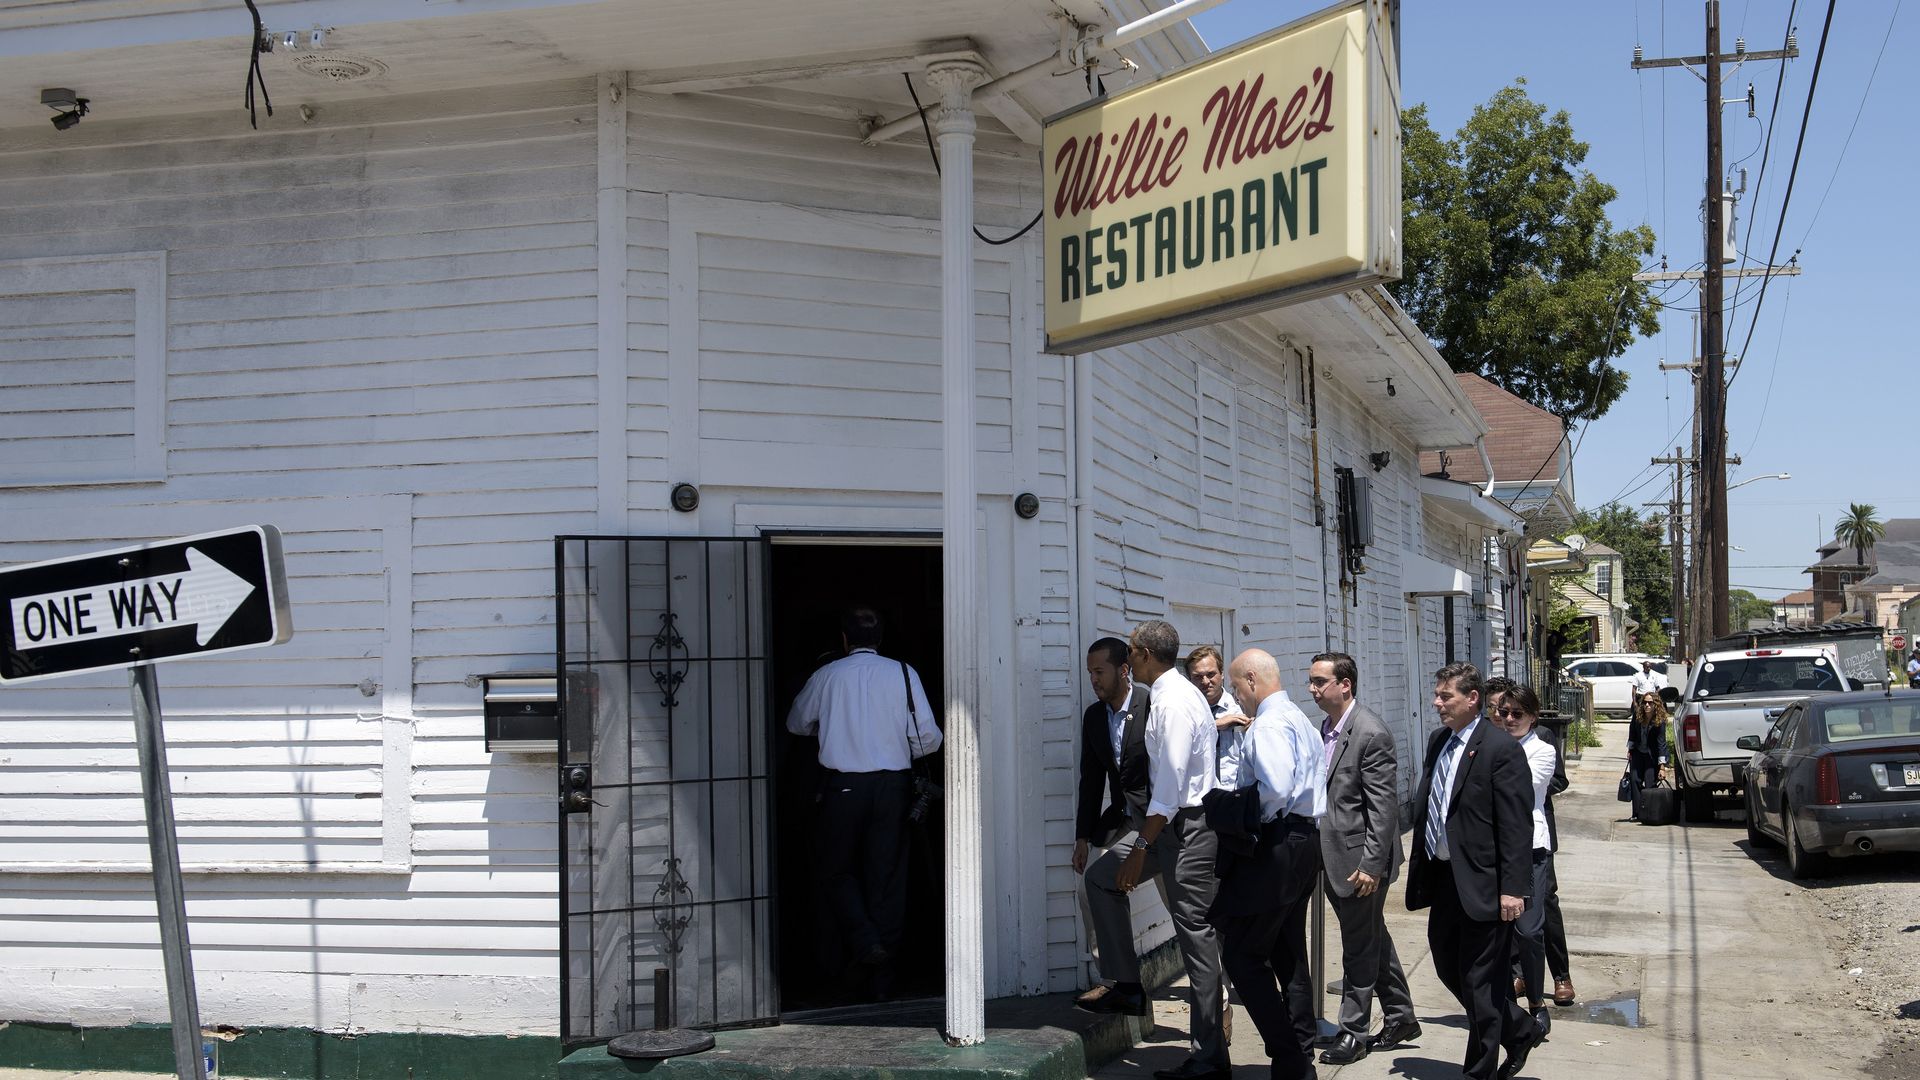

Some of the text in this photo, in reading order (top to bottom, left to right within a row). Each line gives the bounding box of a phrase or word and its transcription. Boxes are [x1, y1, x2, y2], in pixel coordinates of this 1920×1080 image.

[1054, 66, 1334, 219] Willie Mae's
[1061, 157, 1328, 303] RESTAURANT
[23, 578, 182, 642] ONE WAY
